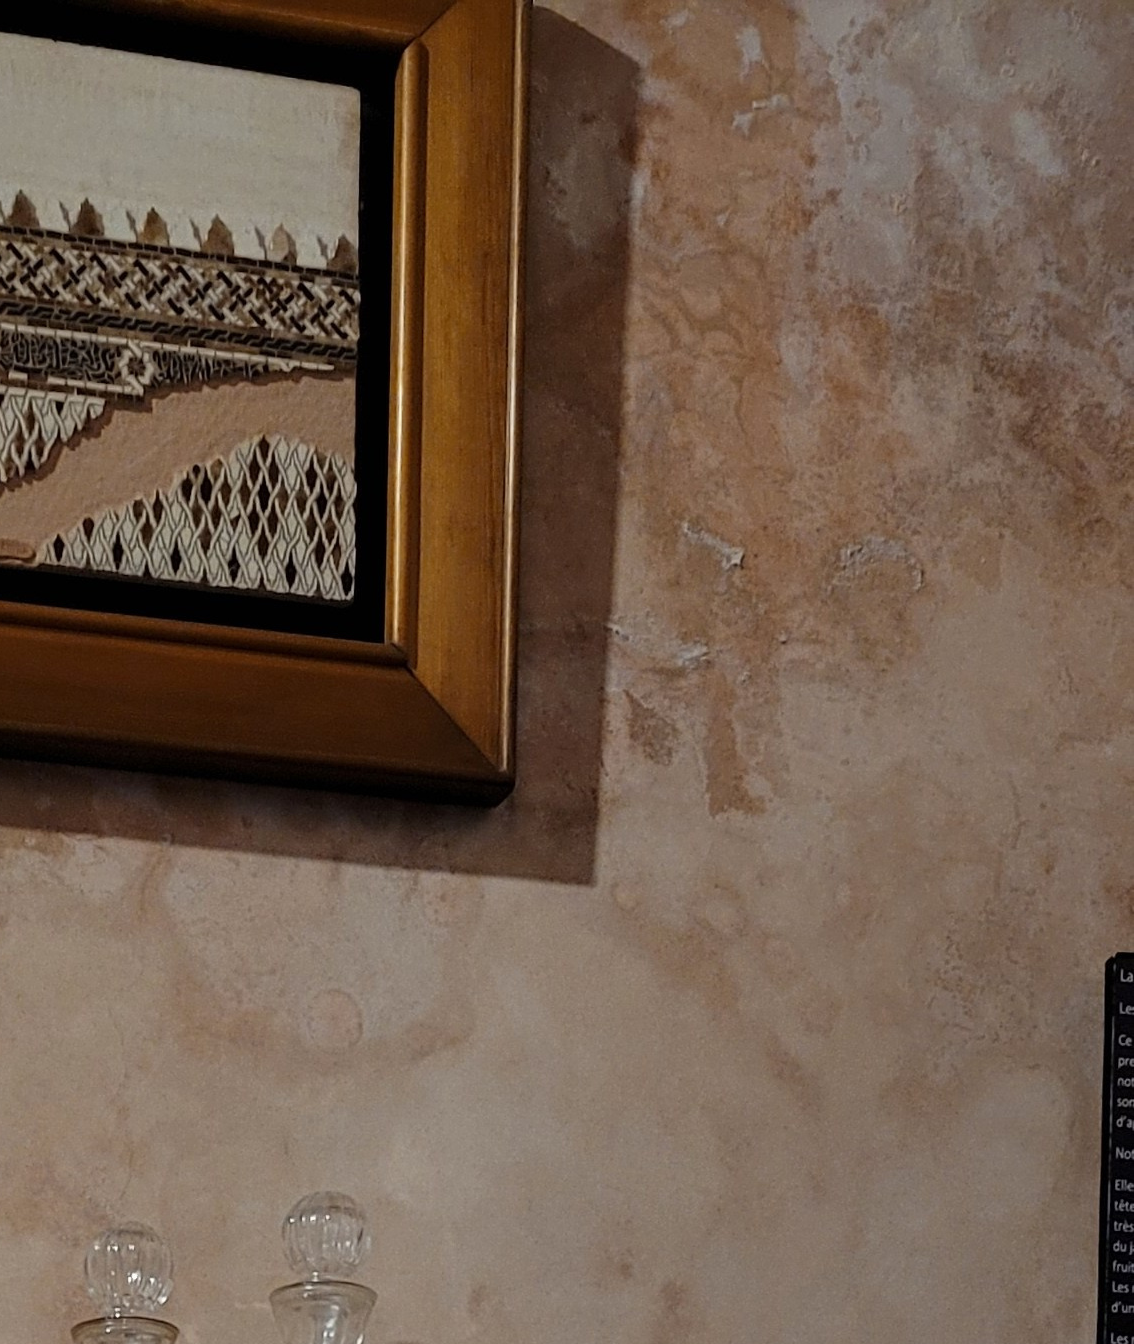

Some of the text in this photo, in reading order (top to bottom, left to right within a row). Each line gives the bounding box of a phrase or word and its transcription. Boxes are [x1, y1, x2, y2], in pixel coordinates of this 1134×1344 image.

[1113, 1240, 1127, 1252] du
[1111, 1280, 1129, 1293] Les
[1110, 1332, 1129, 1344] Les
